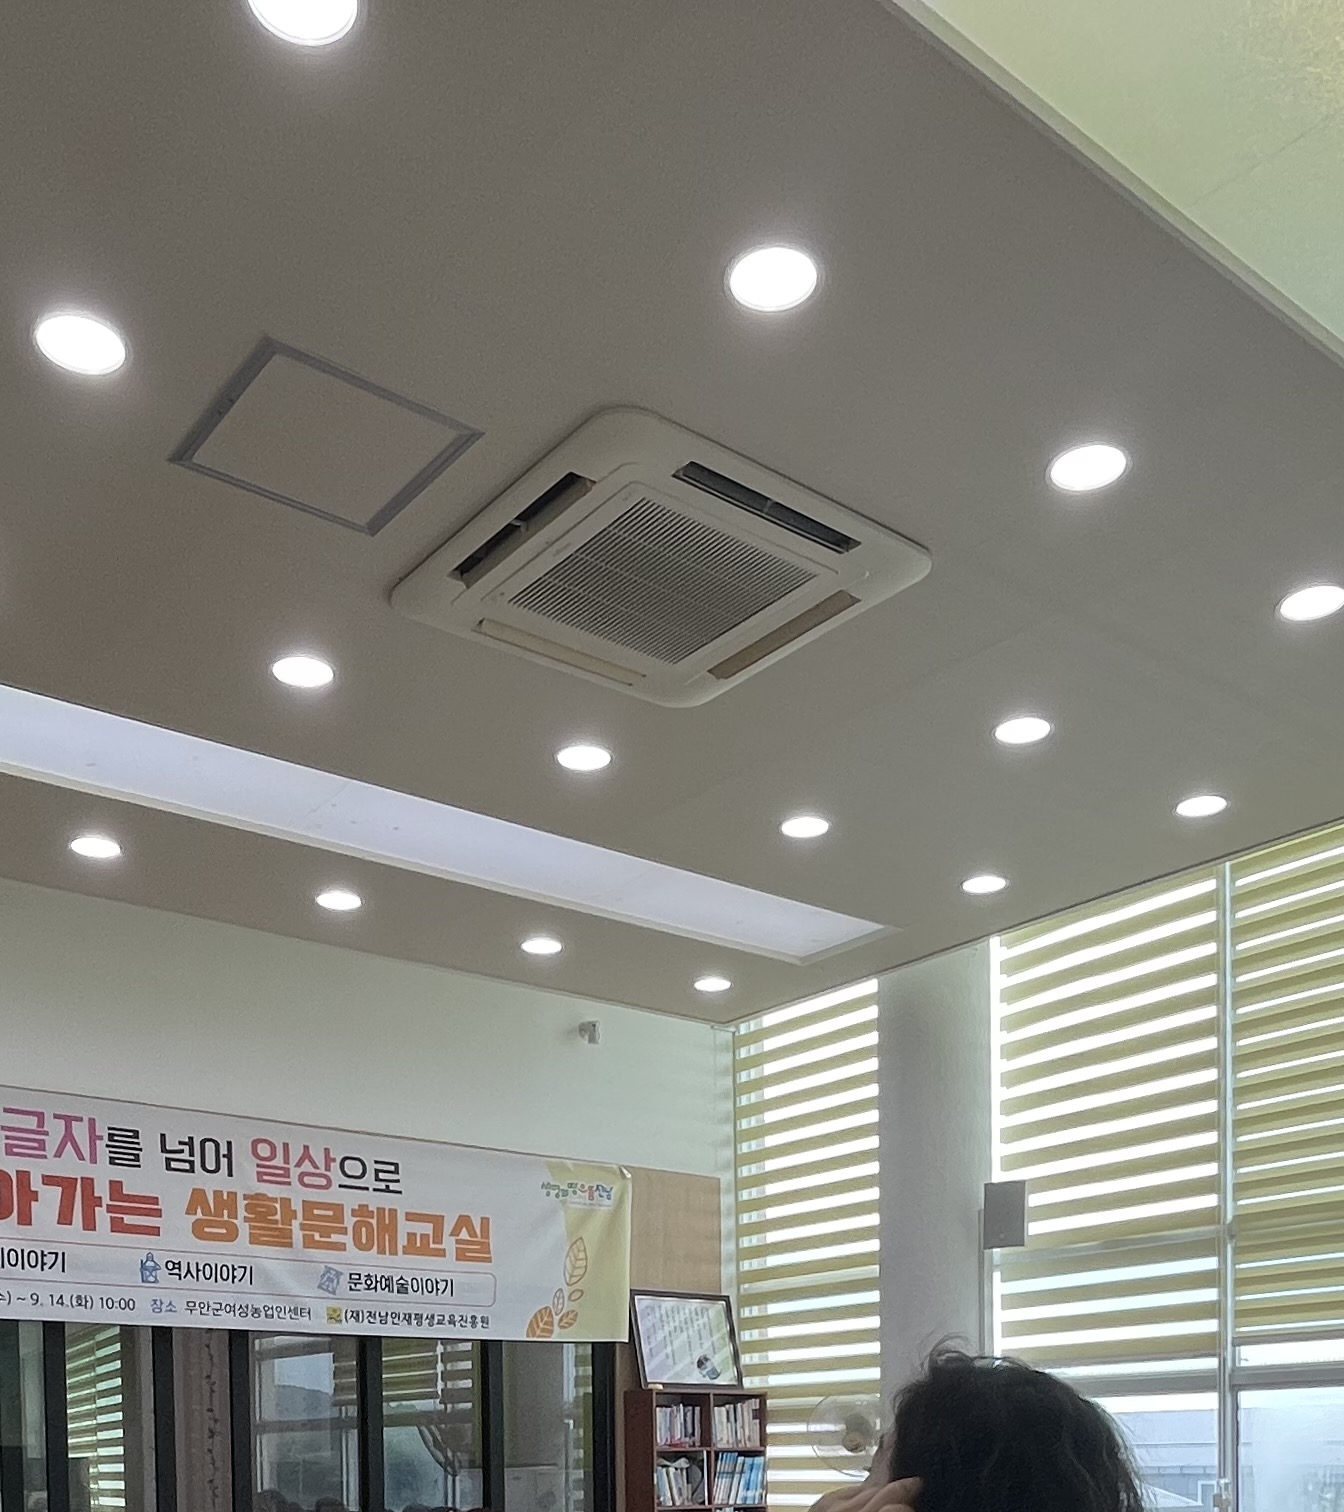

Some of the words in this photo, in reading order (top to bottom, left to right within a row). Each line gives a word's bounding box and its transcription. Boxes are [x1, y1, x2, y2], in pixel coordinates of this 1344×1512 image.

[0, 1107, 143, 1168] 글자를
[159, 1133, 234, 1177] 넘어
[250, 1137, 403, 1195] 일상으로
[185, 1188, 493, 1264] 생활문해교실
[165, 1260, 253, 1285] 역사이야기
[347, 1272, 454, 1297] 문화예술이야기
[99, 1296, 136, 1311] 10:00
[150, 1299, 177, 1314] 장소
[184, 1300, 312, 1321] 무안군여성농업인센터
